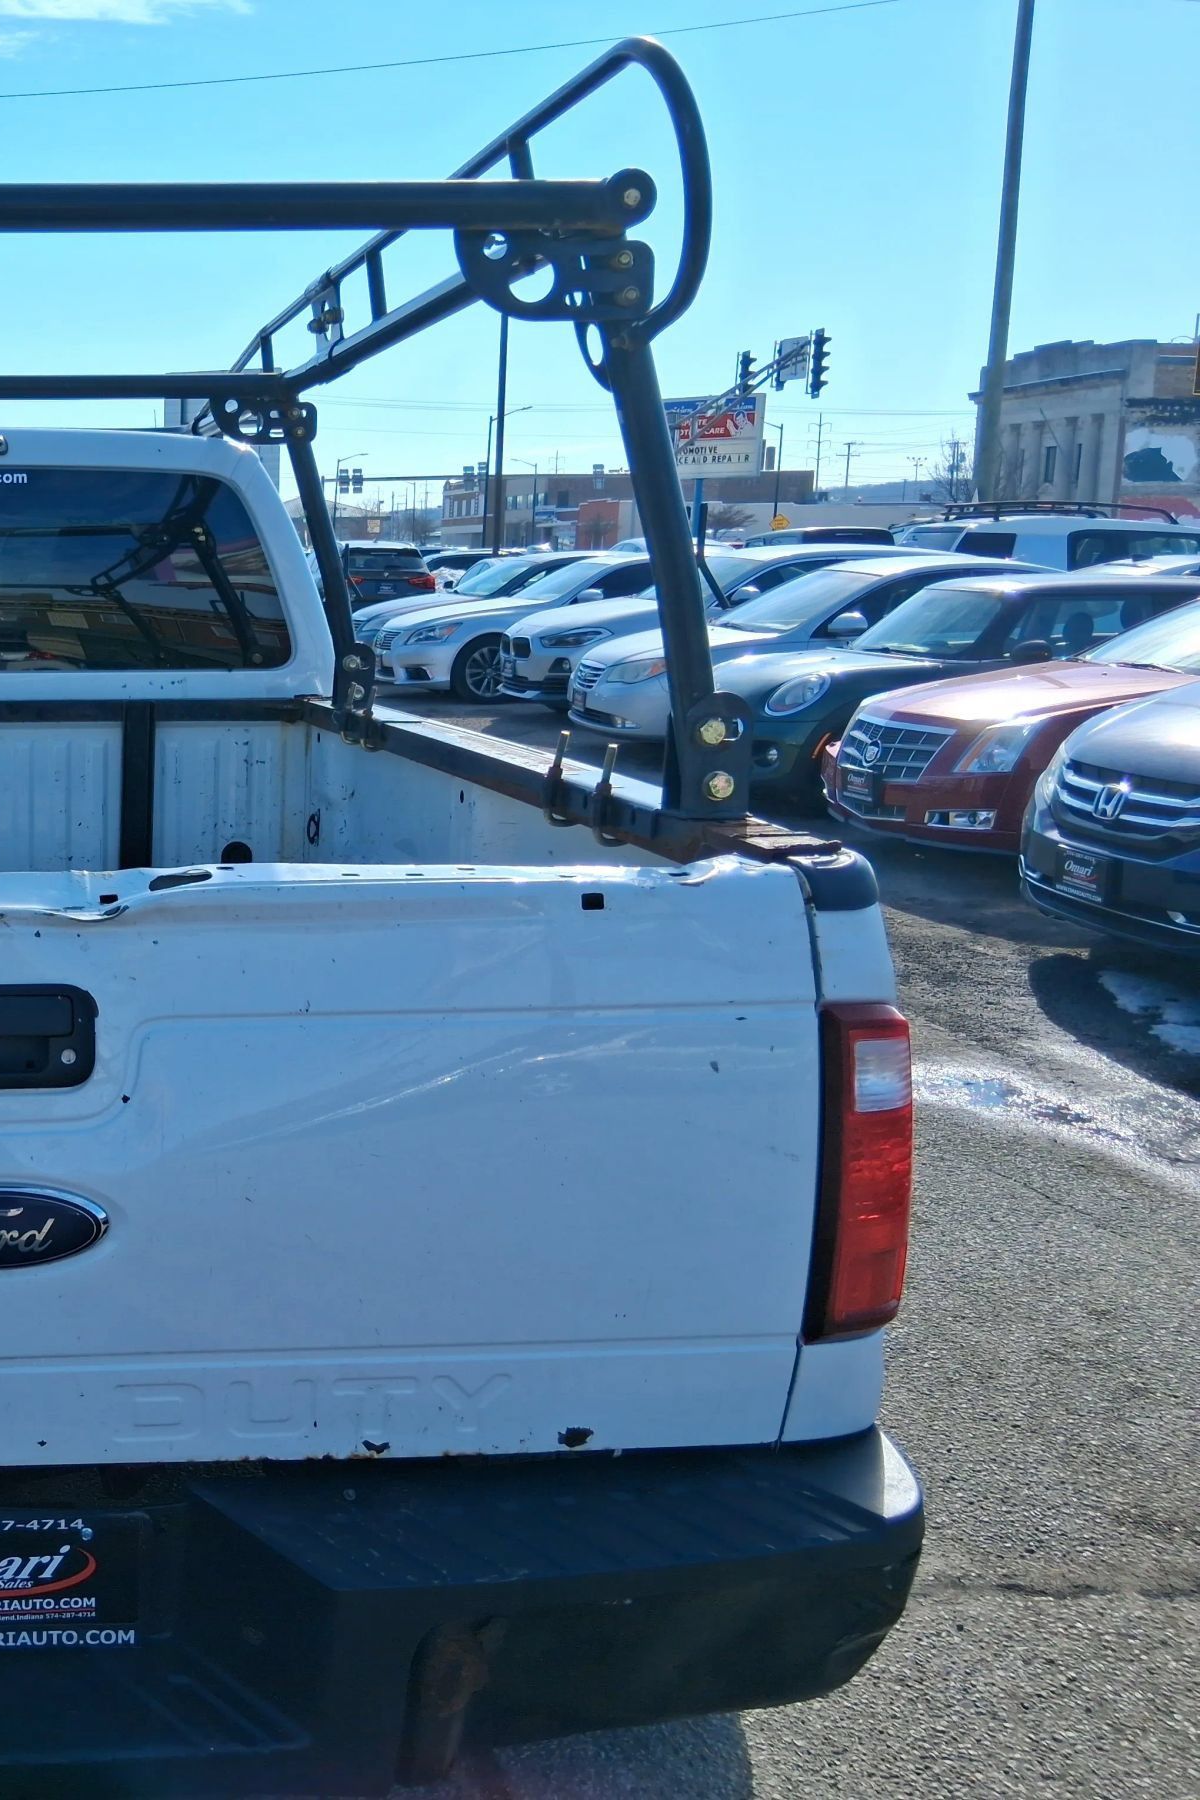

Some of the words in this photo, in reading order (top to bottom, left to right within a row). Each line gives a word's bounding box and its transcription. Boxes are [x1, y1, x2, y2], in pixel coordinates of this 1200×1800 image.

[681, 446, 718, 454] OMOTIVE
[112, 1372, 513, 1443] DUTY
[45, 1611, 96, 1620] 574-287-4714
